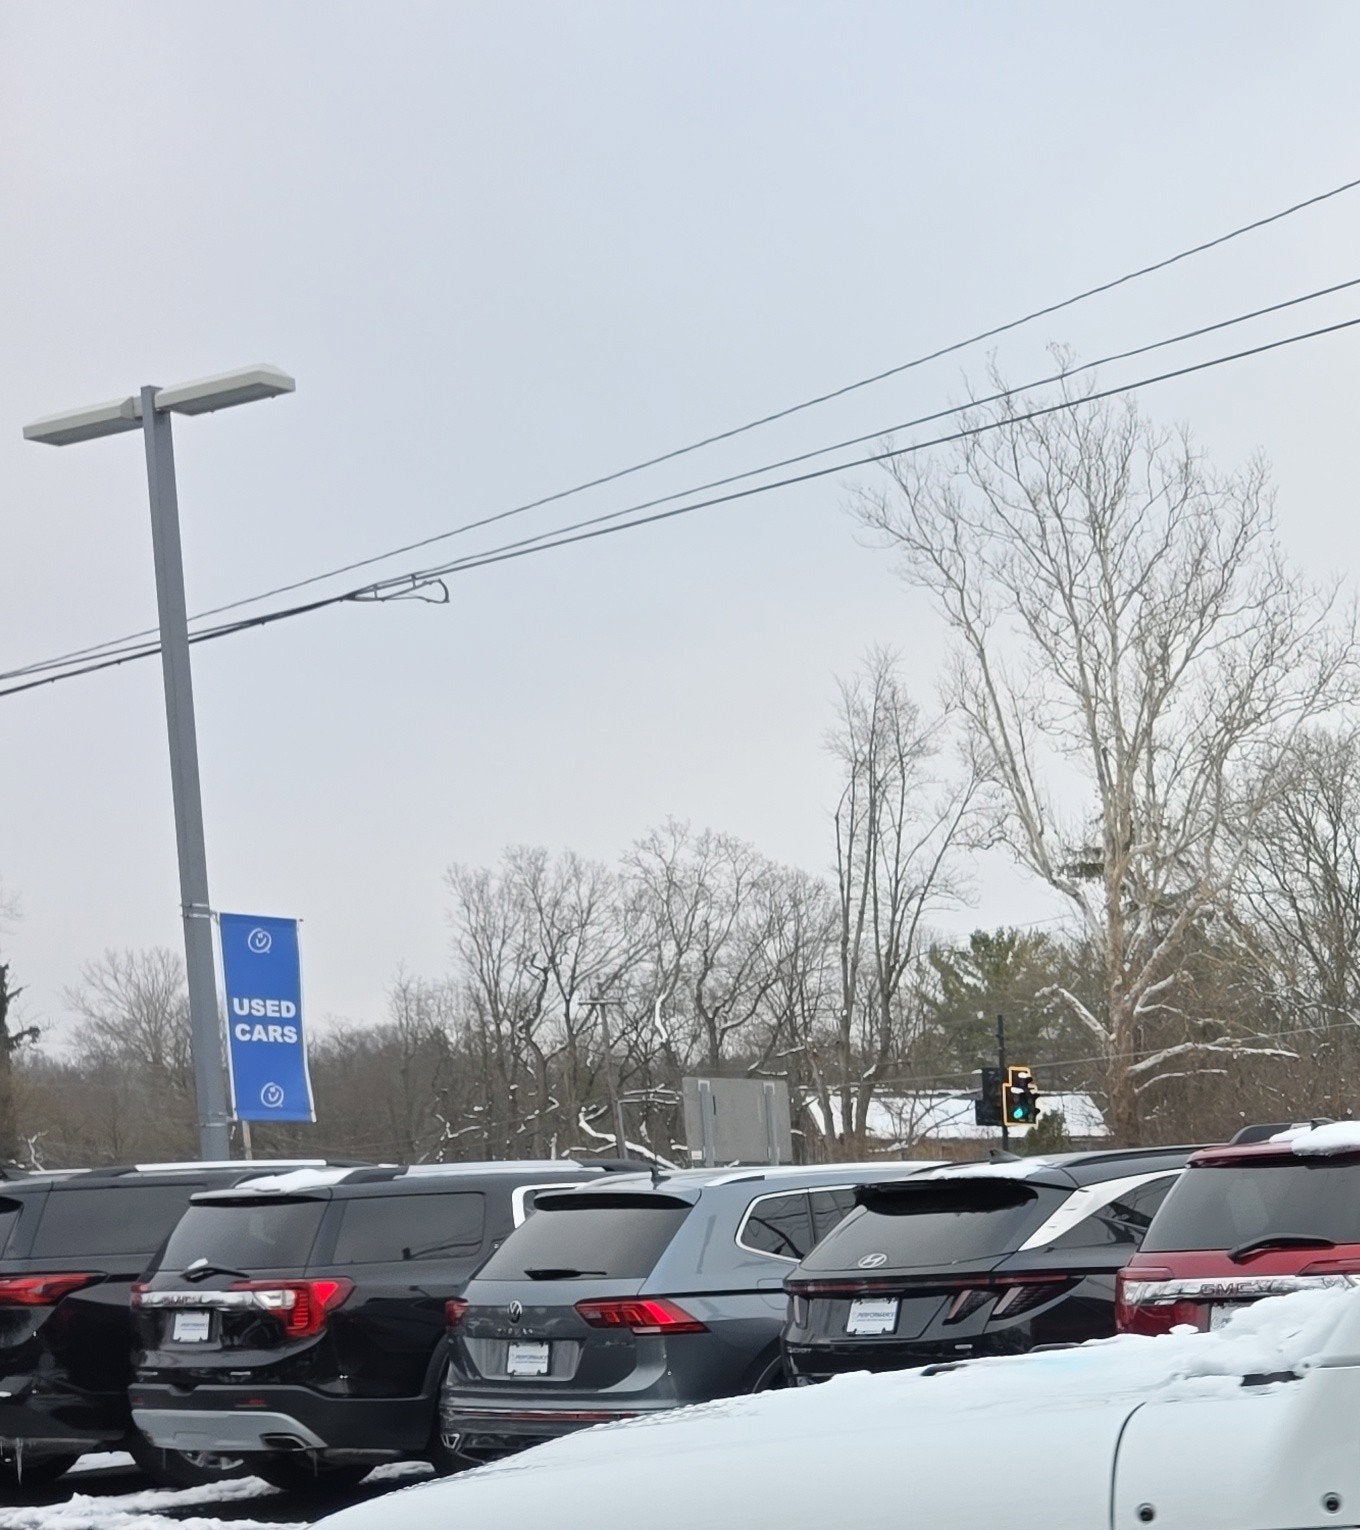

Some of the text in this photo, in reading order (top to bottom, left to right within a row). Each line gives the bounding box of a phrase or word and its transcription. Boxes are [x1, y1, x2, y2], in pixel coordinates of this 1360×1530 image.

[233, 997, 296, 1018] USED
[235, 1023, 298, 1044] CARS
[1200, 1282, 1256, 1295] GMC
